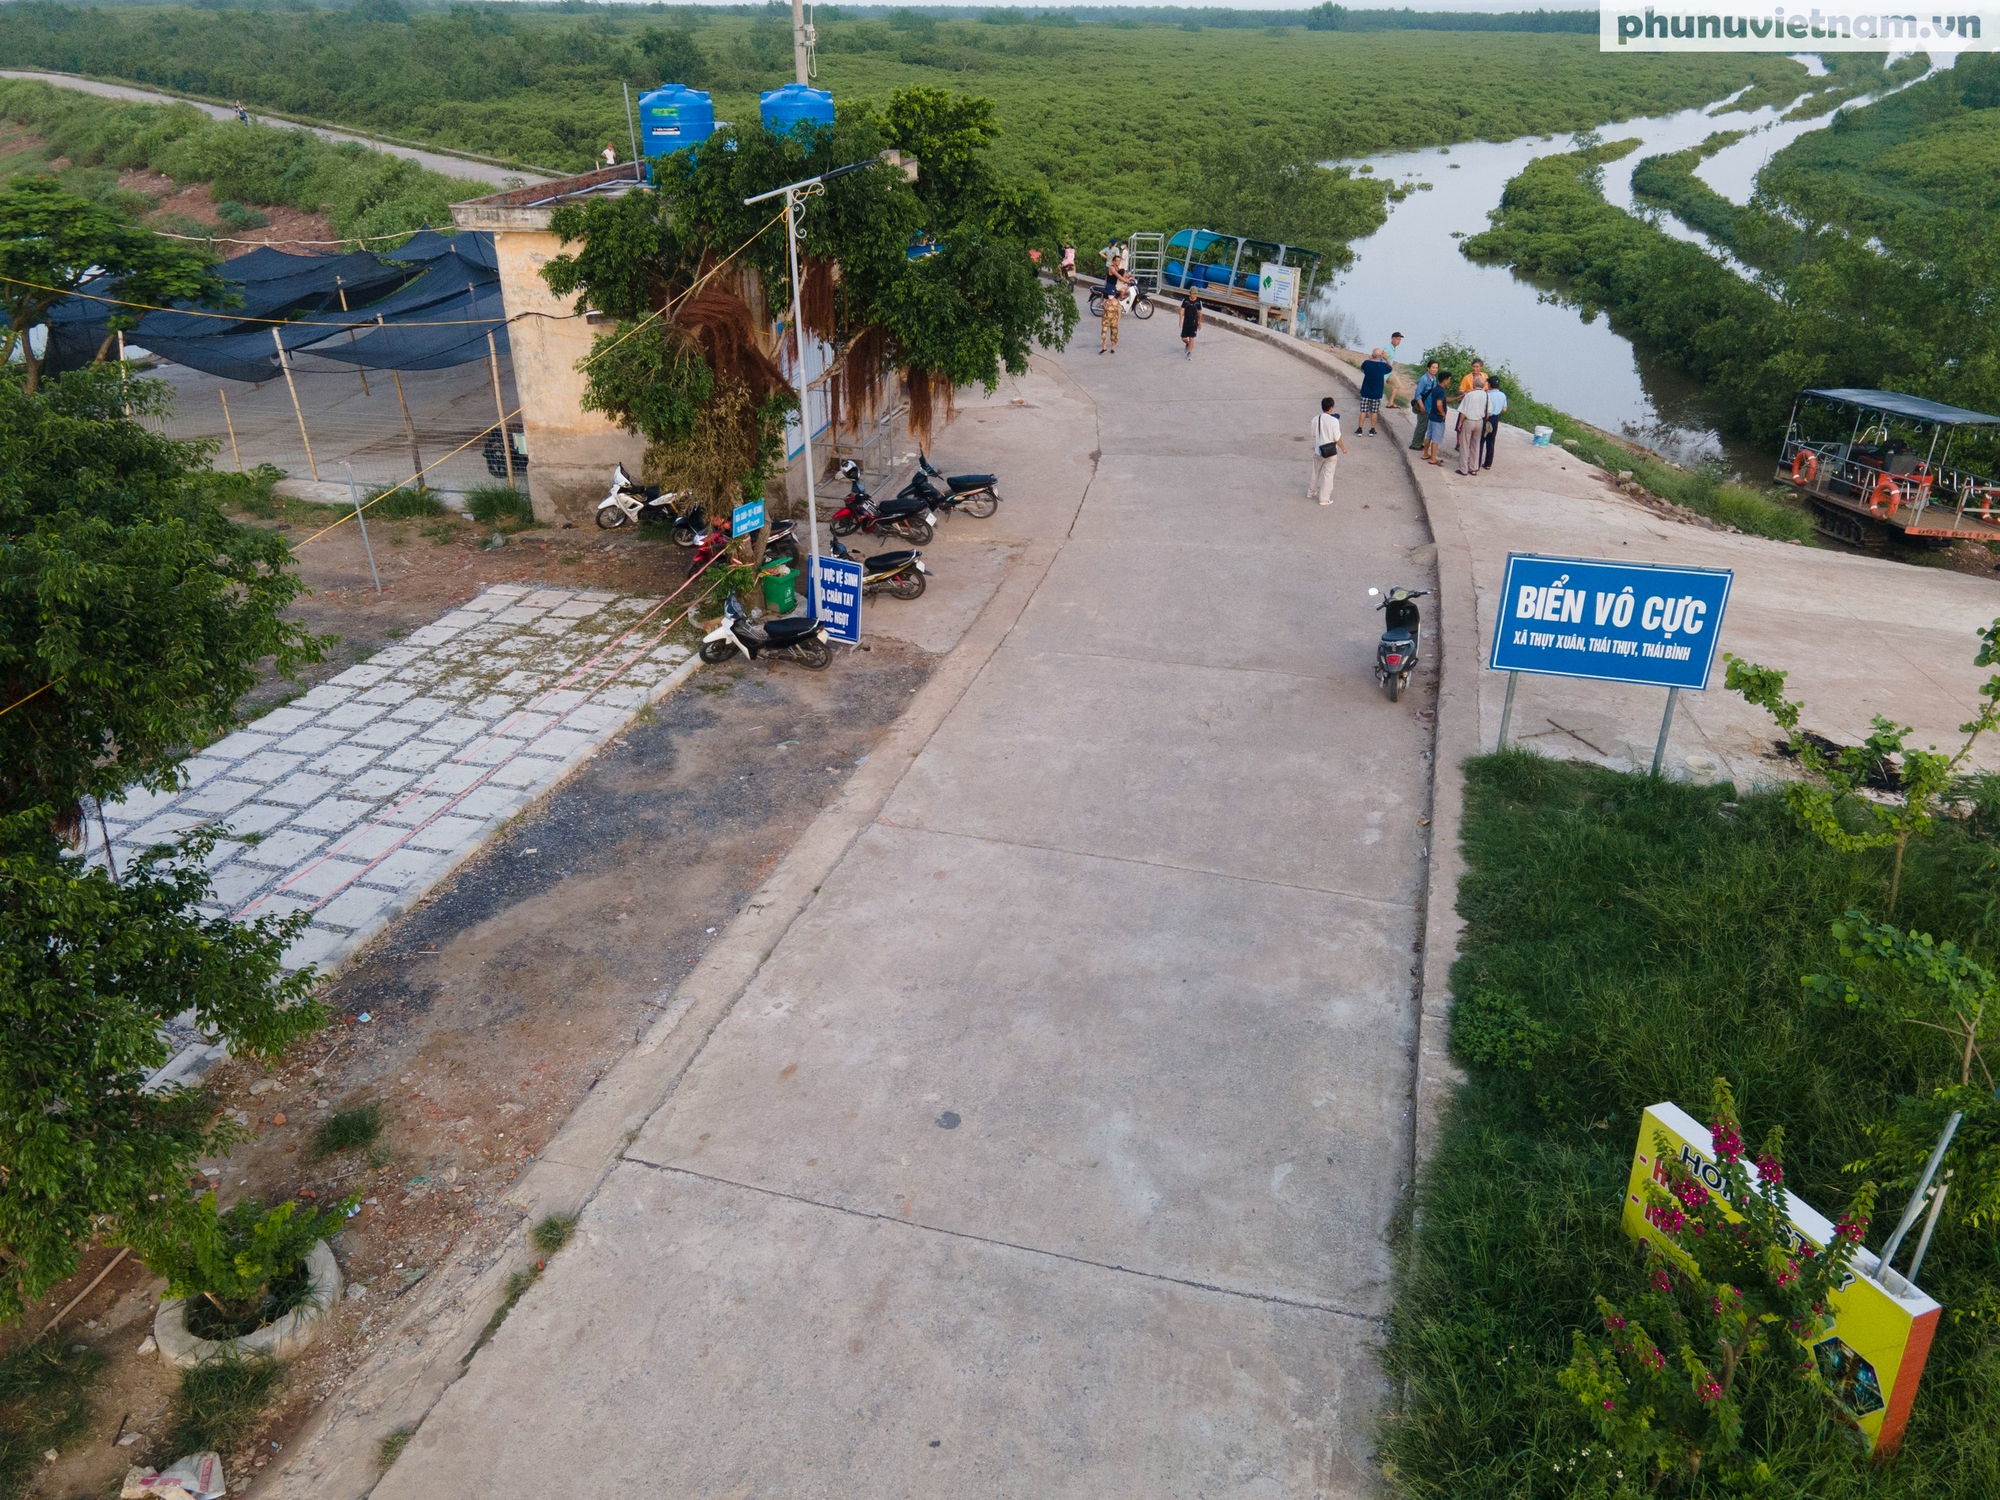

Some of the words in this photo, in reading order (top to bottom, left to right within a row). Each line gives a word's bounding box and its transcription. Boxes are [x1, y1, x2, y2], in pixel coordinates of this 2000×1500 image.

[844, 572, 859, 587] SINH
[843, 592, 854, 607] TAY
[1515, 573, 1587, 624] BIỂN
[1594, 585, 1636, 628] VÔ
[1641, 595, 1708, 639] CỰC
[1512, 629, 1528, 645] XÃ
[1555, 633, 1587, 653] XUÂN,
[1588, 637, 1611, 653] THÁI
[1641, 641, 1665, 658] THÁI
[1664, 643, 1692, 661] BÌNH
